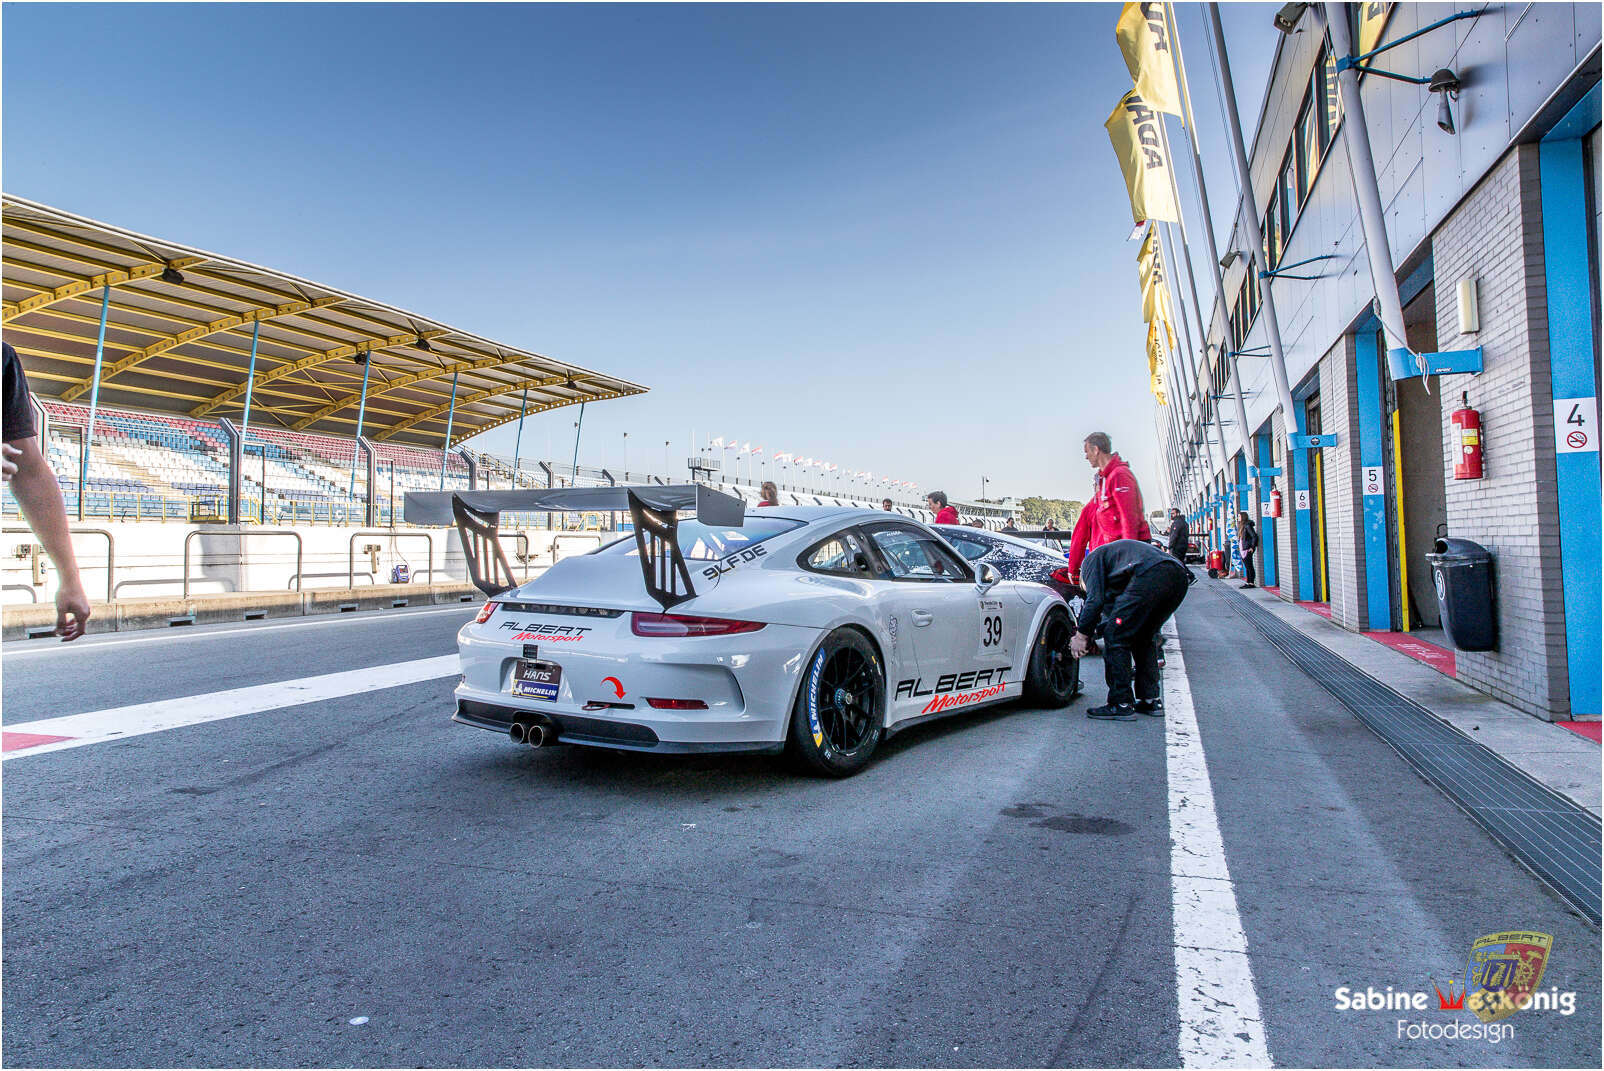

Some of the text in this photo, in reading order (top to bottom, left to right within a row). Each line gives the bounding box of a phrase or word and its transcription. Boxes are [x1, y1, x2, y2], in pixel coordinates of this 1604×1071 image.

[1567, 403, 1585, 427] 4
[1368, 469, 1377, 482] 5
[1299, 492, 1306, 501] 6
[1263, 503, 1269, 511] 7
[702, 544, 768, 580] 9LF.DE
[499, 621, 592, 636] ALBERT
[511, 631, 584, 643] Motorsport
[983, 615, 1002, 647] 39
[523, 686, 557, 697] MICHELIN
[808, 653, 823, 721] MICHELIN
[894, 666, 1012, 702] ALBERT
[921, 681, 1006, 714] Motorsport
